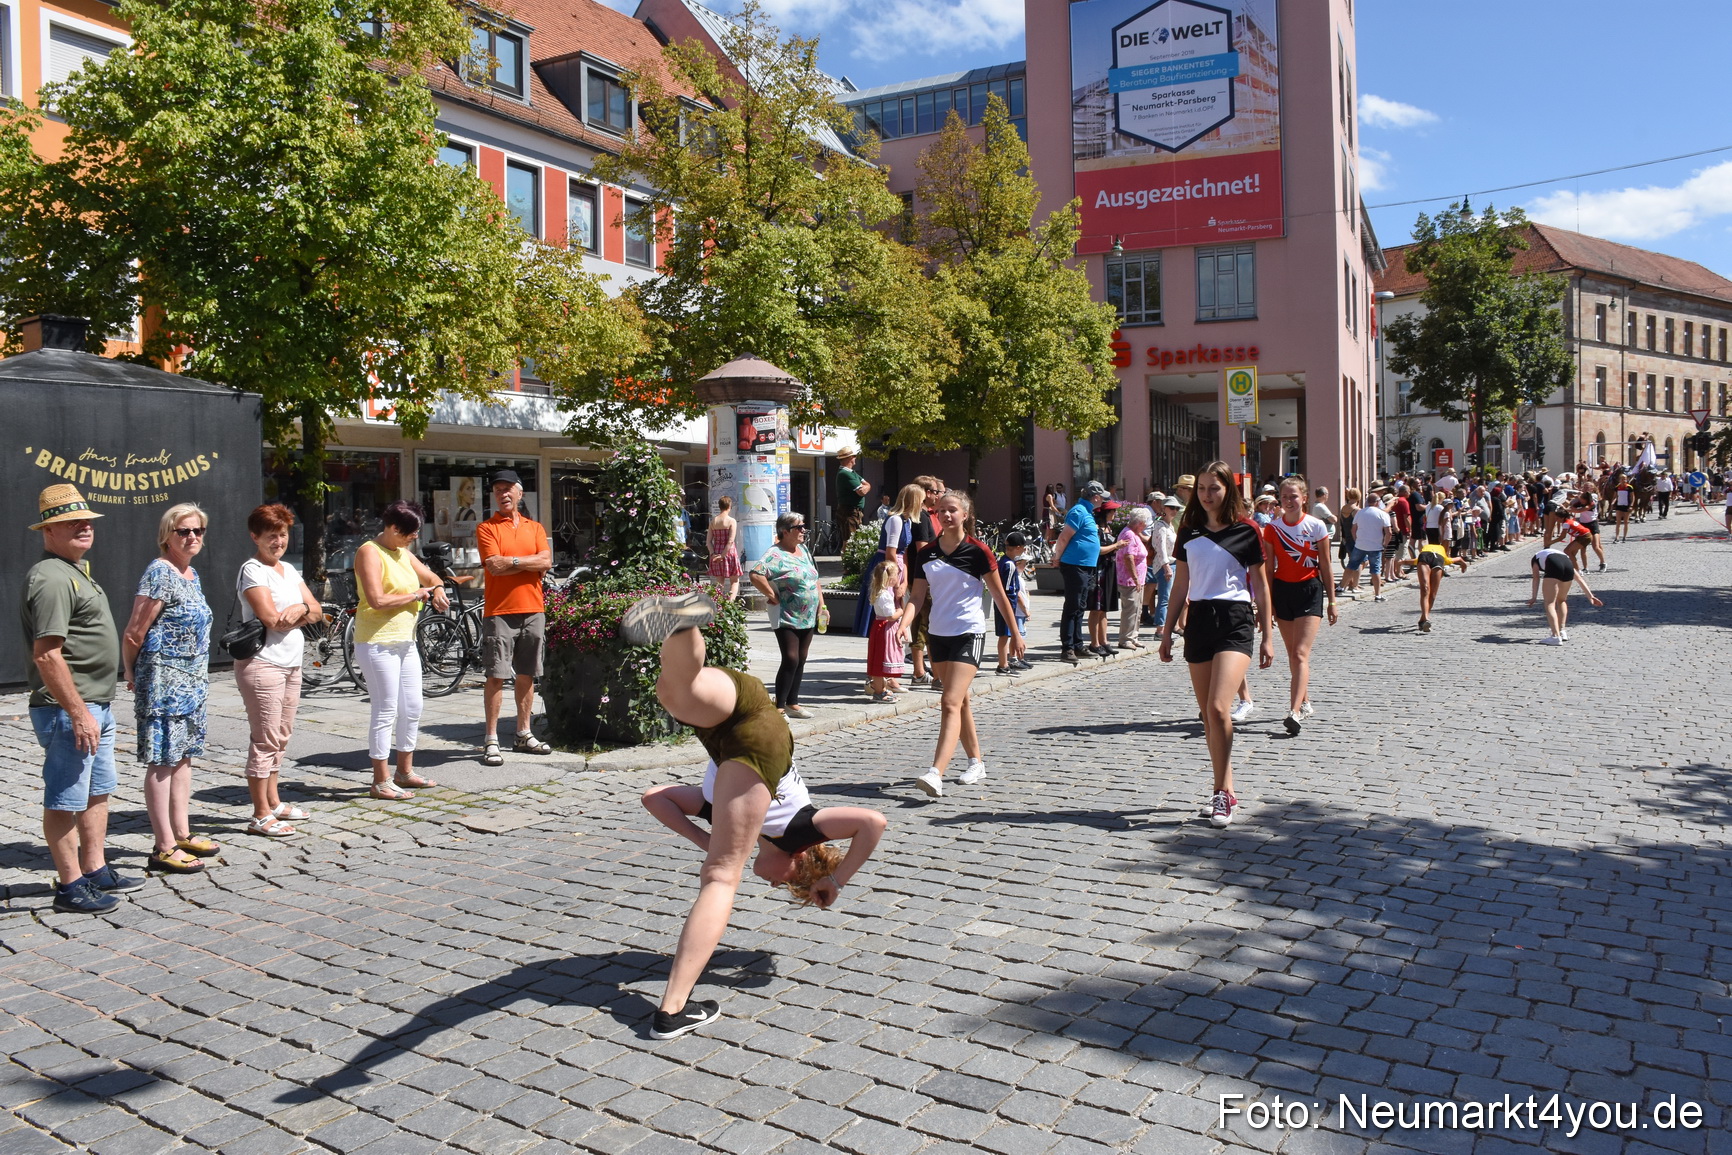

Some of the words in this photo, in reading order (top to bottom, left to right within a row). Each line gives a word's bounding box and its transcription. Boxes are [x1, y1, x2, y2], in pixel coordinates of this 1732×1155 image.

[1120, 31, 1150, 49] DIE
[1149, 51, 1180, 61] September
[1131, 66, 1160, 77] SIEGER
[1161, 59, 1215, 73] BANKENTEST
[1120, 76, 1158, 88] Beratung
[1159, 67, 1228, 83] Baufinanzierung
[1151, 88, 1196, 101] Sparkasse
[1131, 95, 1217, 112] Neumarkt-Parsberg
[1138, 112, 1158, 120] Banken
[1165, 108, 1193, 117] Neumarkt
[1094, 173, 1261, 210] Ausgezeichnet!
[1217, 218, 1247, 226] Sparkasse
[1217, 223, 1273, 233] Neumarkt-Parsberg
[1146, 343, 1260, 370] Sparkasse
[1235, 376, 1247, 390] H
[753, 416, 775, 424] BOXEN
[78, 446, 118, 468] Hans
[34, 448, 211, 491] BRATWURSTHAUS
[87, 491, 127, 505] NEUMARKT
[133, 494, 149, 505] SEIT
[151, 492, 169, 503] 1858
